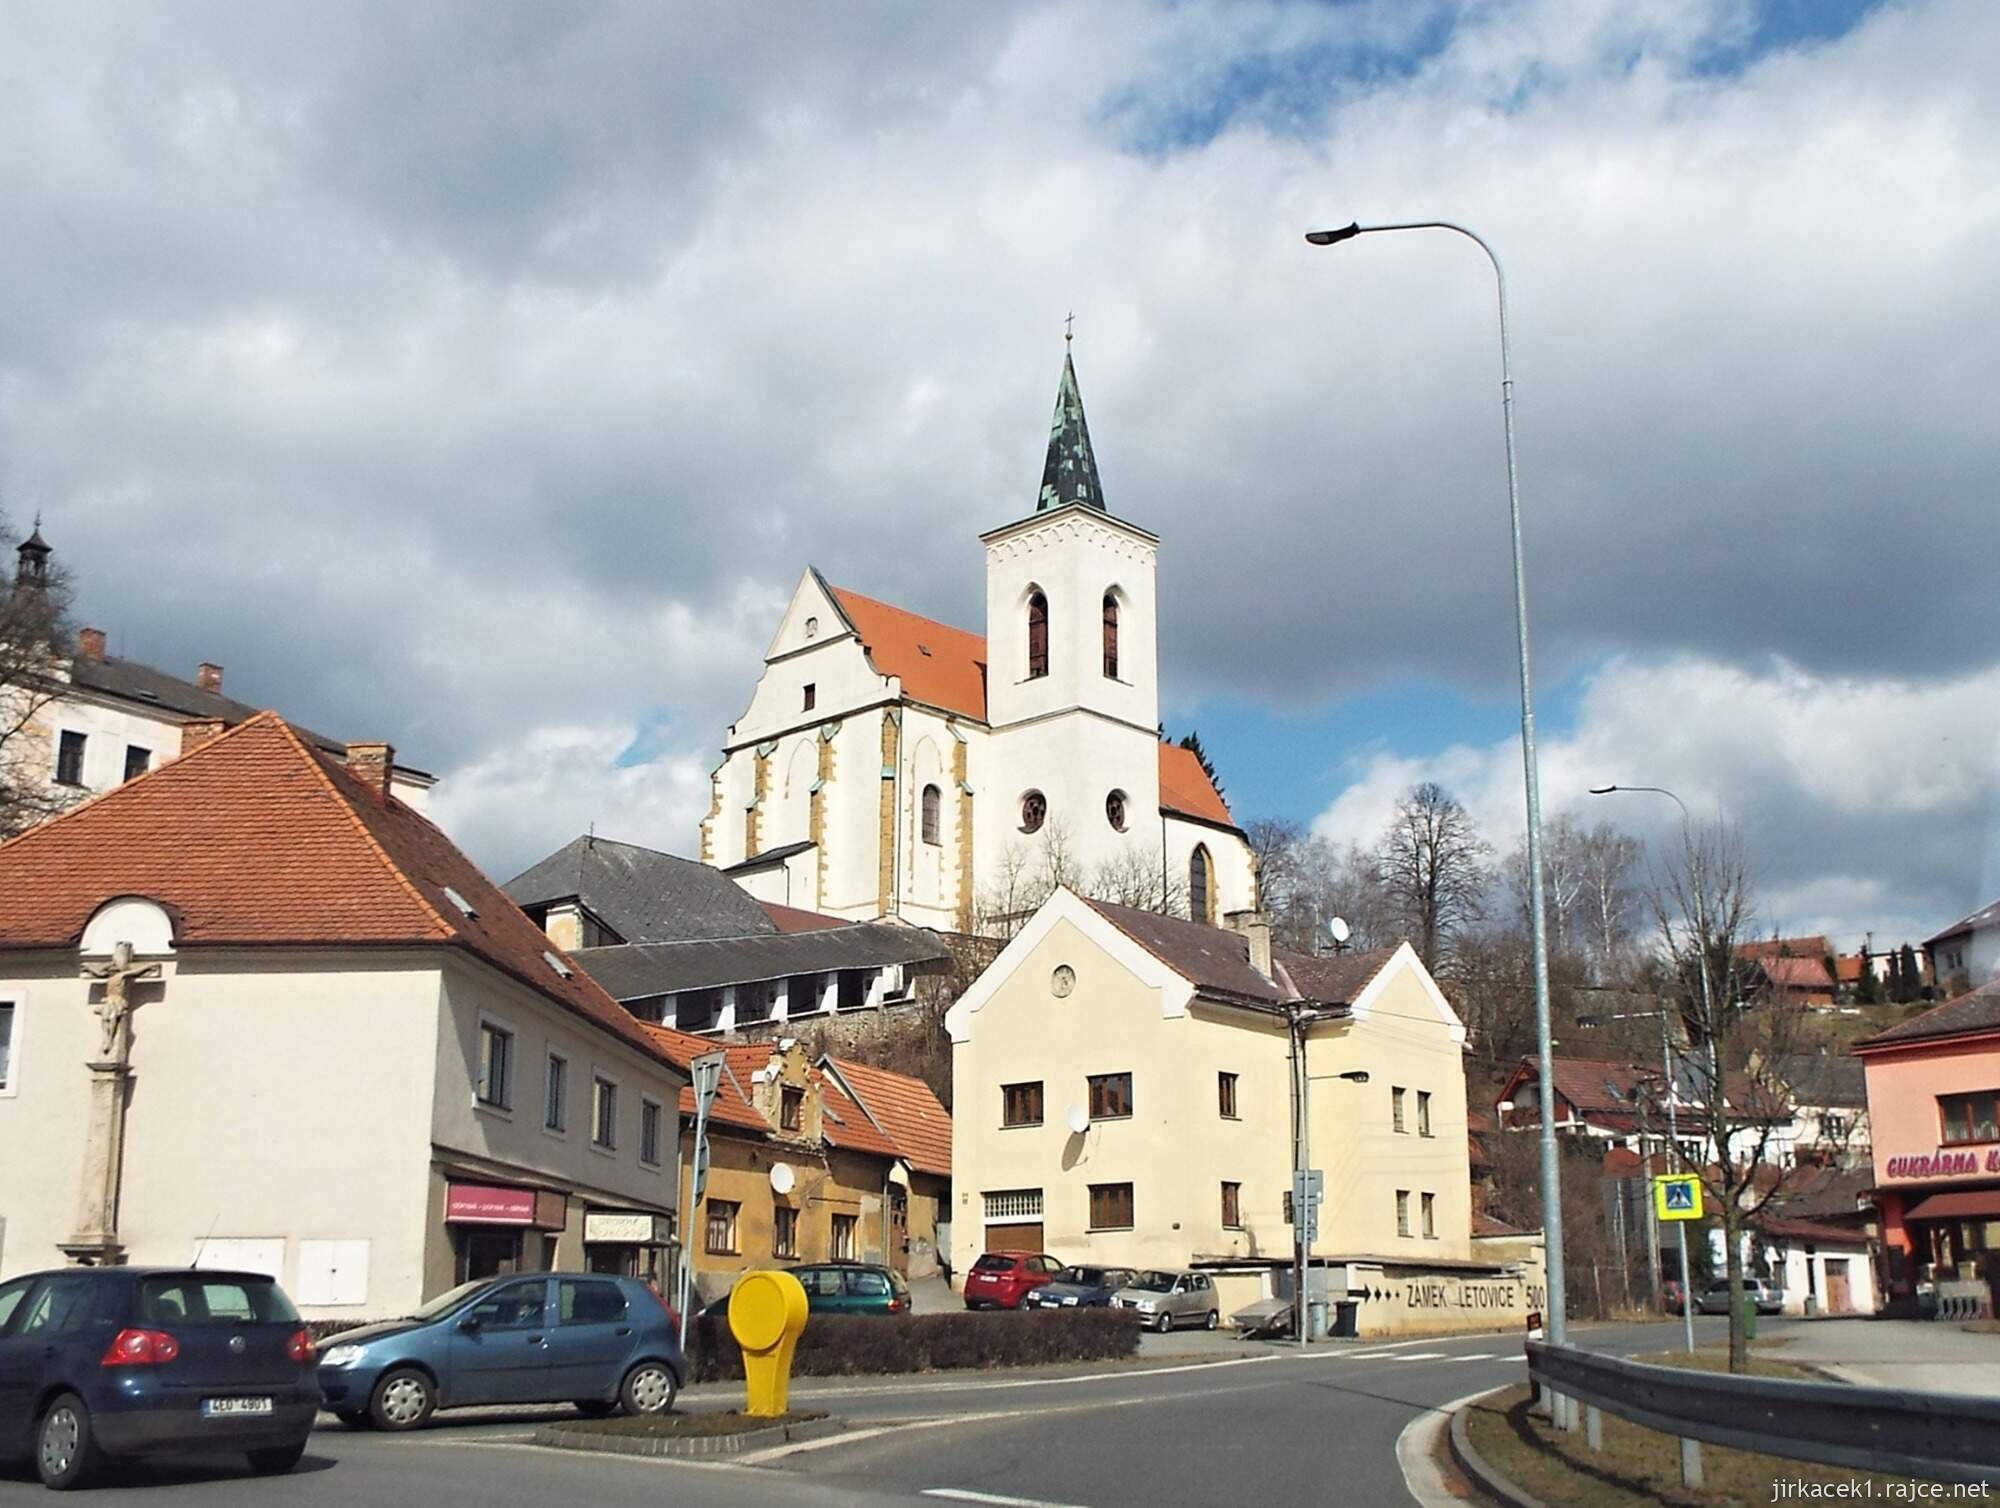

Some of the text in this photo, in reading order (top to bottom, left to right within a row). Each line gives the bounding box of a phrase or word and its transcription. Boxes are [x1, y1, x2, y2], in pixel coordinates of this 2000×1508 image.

[1985, 1149, 2000, 1174] K
[1406, 1279, 1448, 1308] ZÁMEK
[1458, 1284, 1515, 1308] LETOVICE
